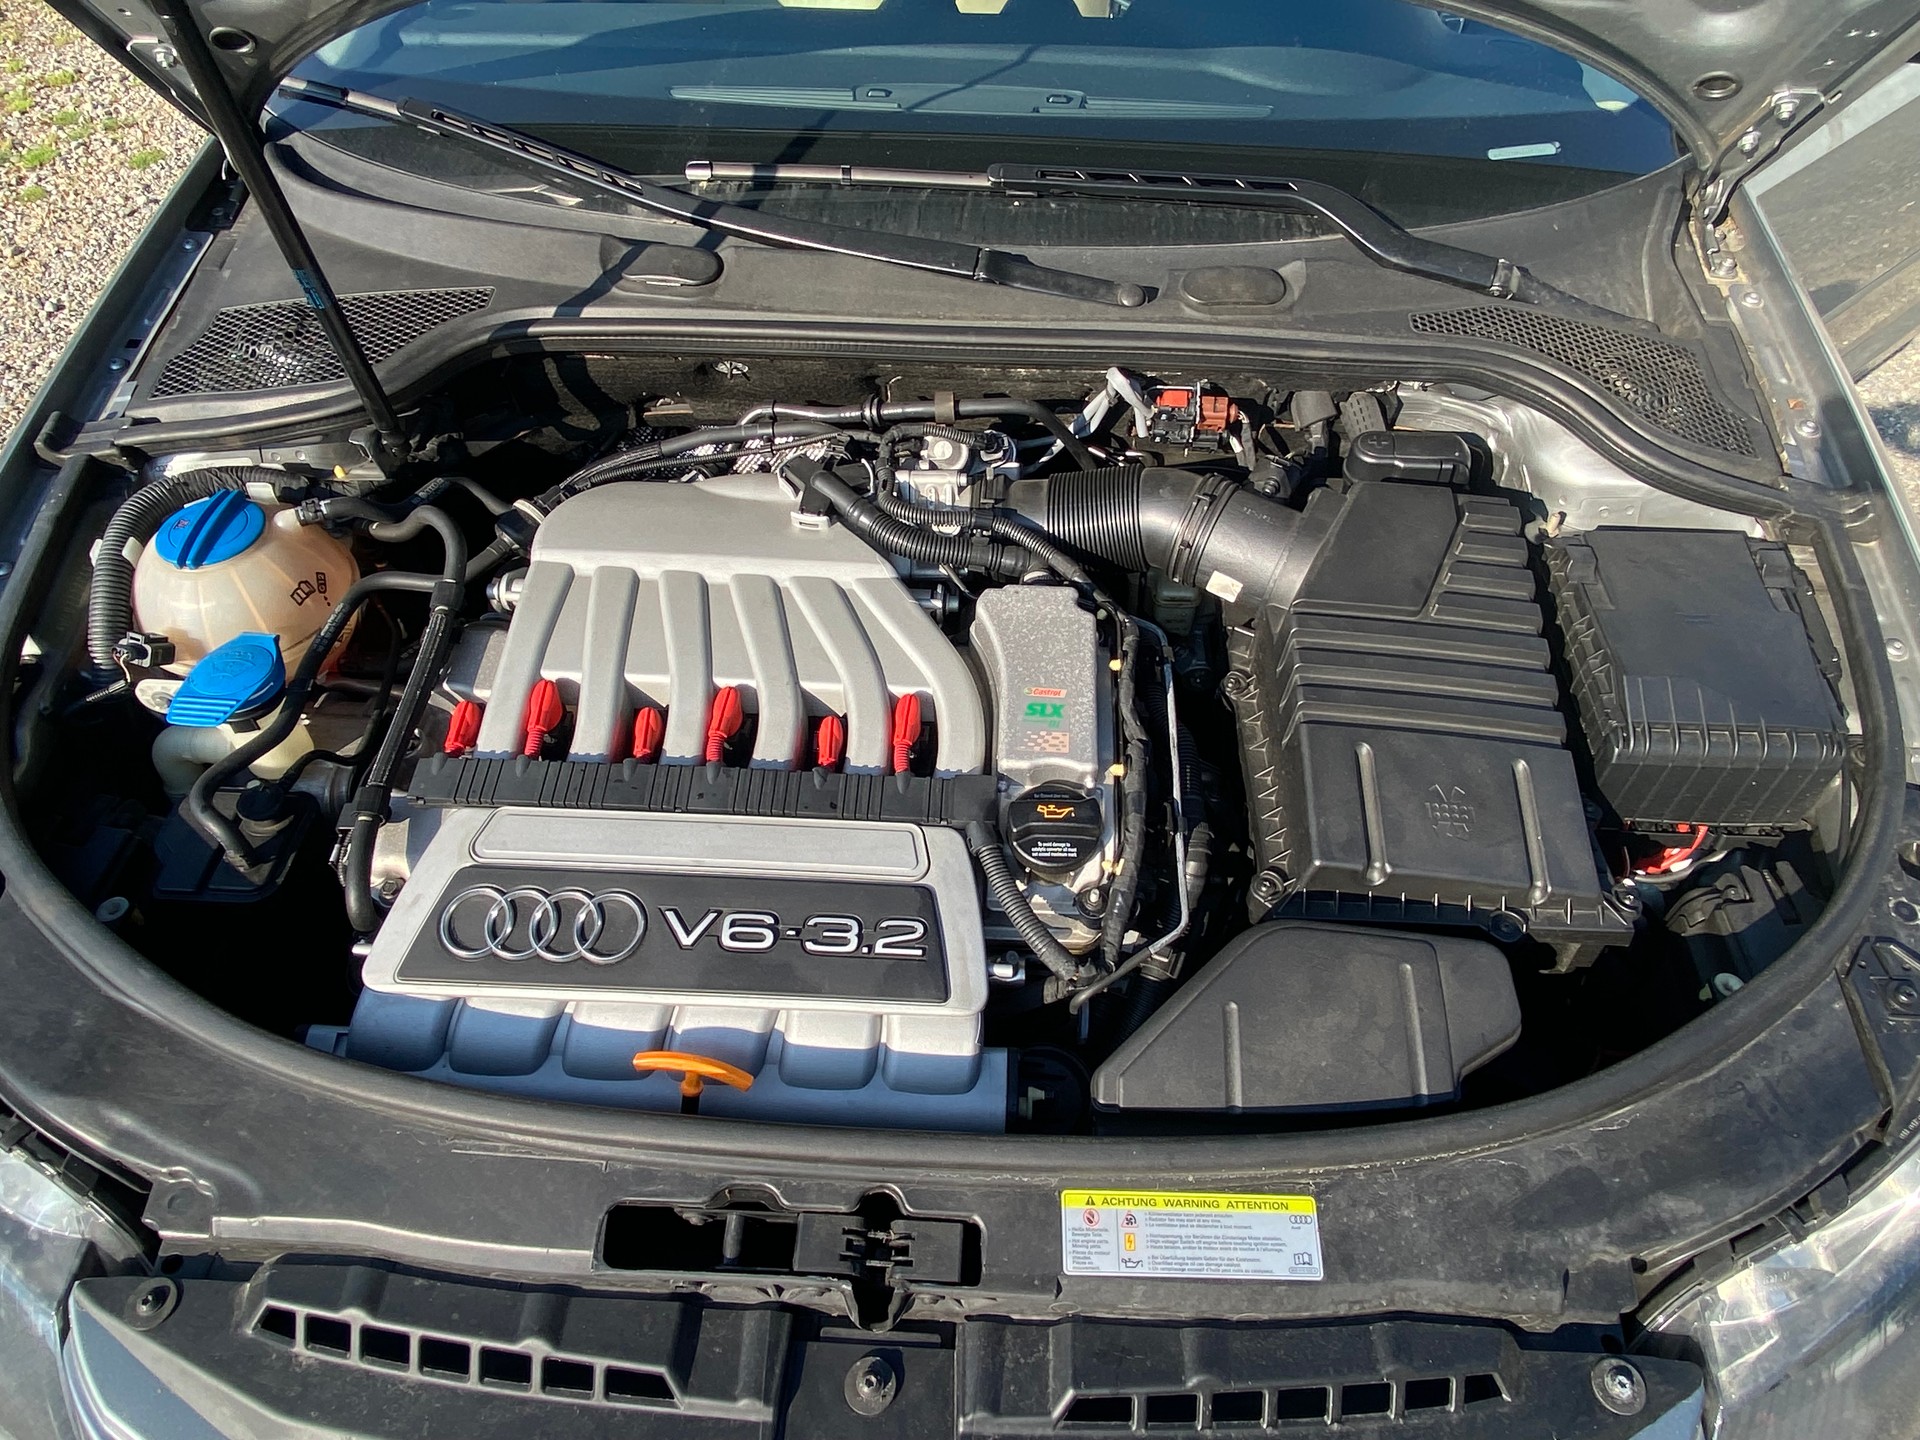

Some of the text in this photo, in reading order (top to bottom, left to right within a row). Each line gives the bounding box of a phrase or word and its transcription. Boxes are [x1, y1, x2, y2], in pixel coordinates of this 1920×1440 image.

[1033, 688, 1062, 696] Castrol
[1024, 702, 1065, 718] SLX
[1101, 1197, 1289, 1210] ACHTUNG WARNING ATTENTION
